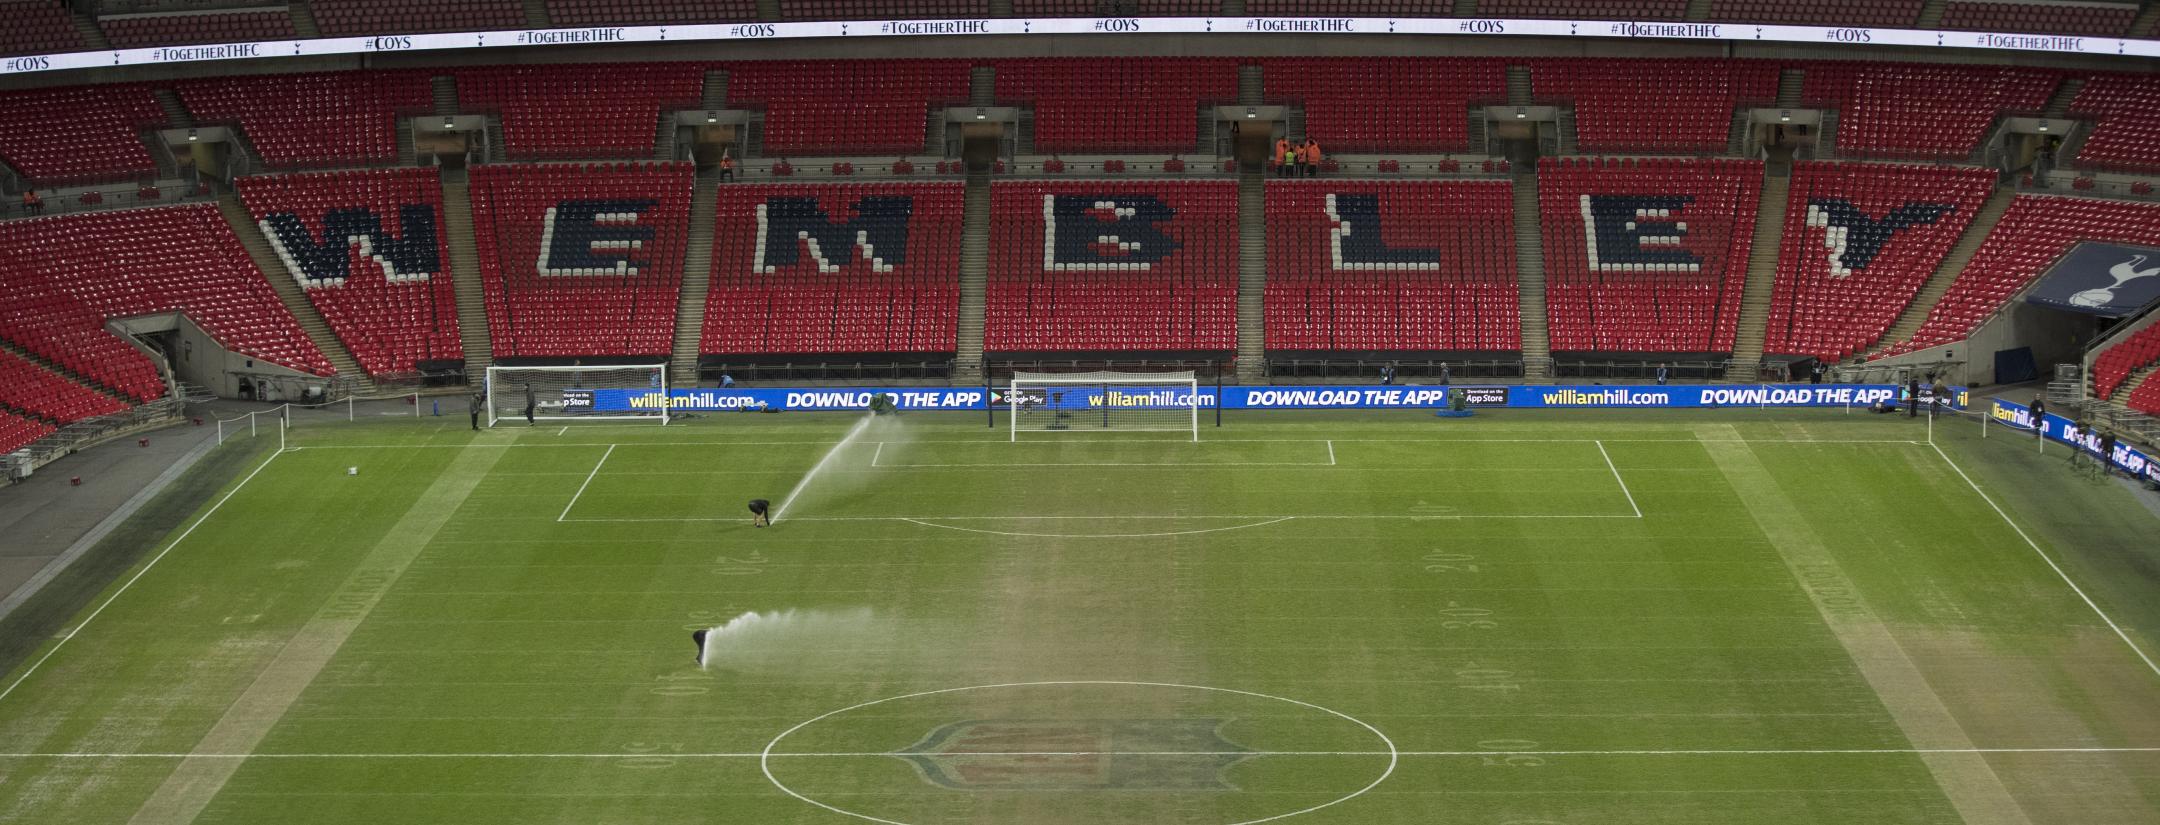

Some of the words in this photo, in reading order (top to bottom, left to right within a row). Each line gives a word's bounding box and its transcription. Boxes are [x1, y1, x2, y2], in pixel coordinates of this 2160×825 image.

[732, 24, 775, 38] #COYS
[1096, 19, 1139, 32] #COYS
[1461, 20, 1504, 34] #COYS
[1827, 28, 1870, 42] #COYS
[366, 36, 411, 51] #COYS
[6, 56, 49, 71] #COYS
[570, 398, 590, 406] Store
[629, 393, 754, 408] williamhill.com
[786, 392, 898, 407] DOWNLOD
[903, 392, 945, 407] THE
[947, 392, 981, 407] APP
[1089, 391, 1215, 407] wlliamhill.com
[1247, 390, 1361, 406] DOWNLOAD
[1364, 390, 1401, 405] THE
[1402, 390, 1443, 405] APP
[1466, 395, 1482, 404] App
[1543, 389, 1668, 405] williamhill.com
[1700, 389, 1811, 404] DOWNLOAD
[1814, 389, 1852, 404] THE
[1853, 389, 1893, 404] APP
[2112, 445, 2128, 465] THE
[2127, 453, 2145, 473] APP
